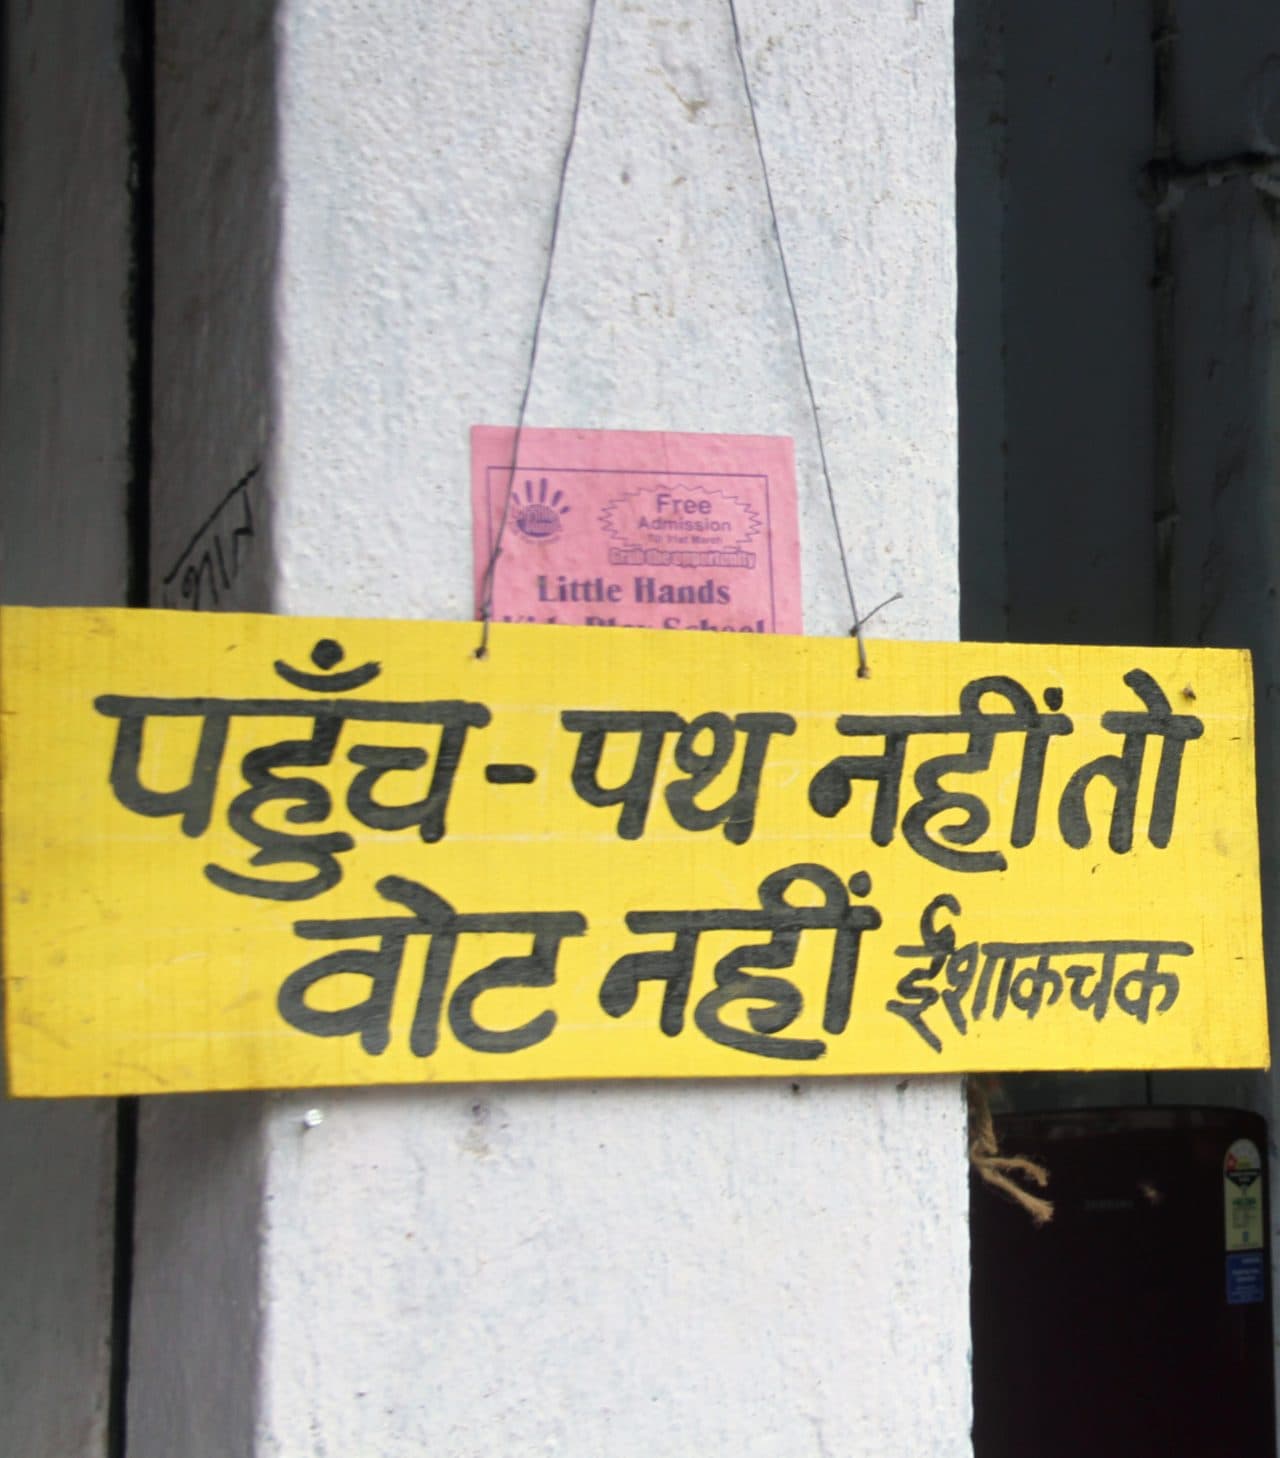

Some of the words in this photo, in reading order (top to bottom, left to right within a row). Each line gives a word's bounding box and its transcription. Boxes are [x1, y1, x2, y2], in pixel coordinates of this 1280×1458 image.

[656, 493, 712, 514] Free
[637, 516, 732, 532] Admission
[536, 575, 623, 602] Little
[634, 576, 731, 604] Hands
[808, 675, 1073, 872] नहीं
[1057, 668, 1205, 854] तो
[277, 875, 588, 1057] वोट
[599, 862, 882, 1061] नहीं
